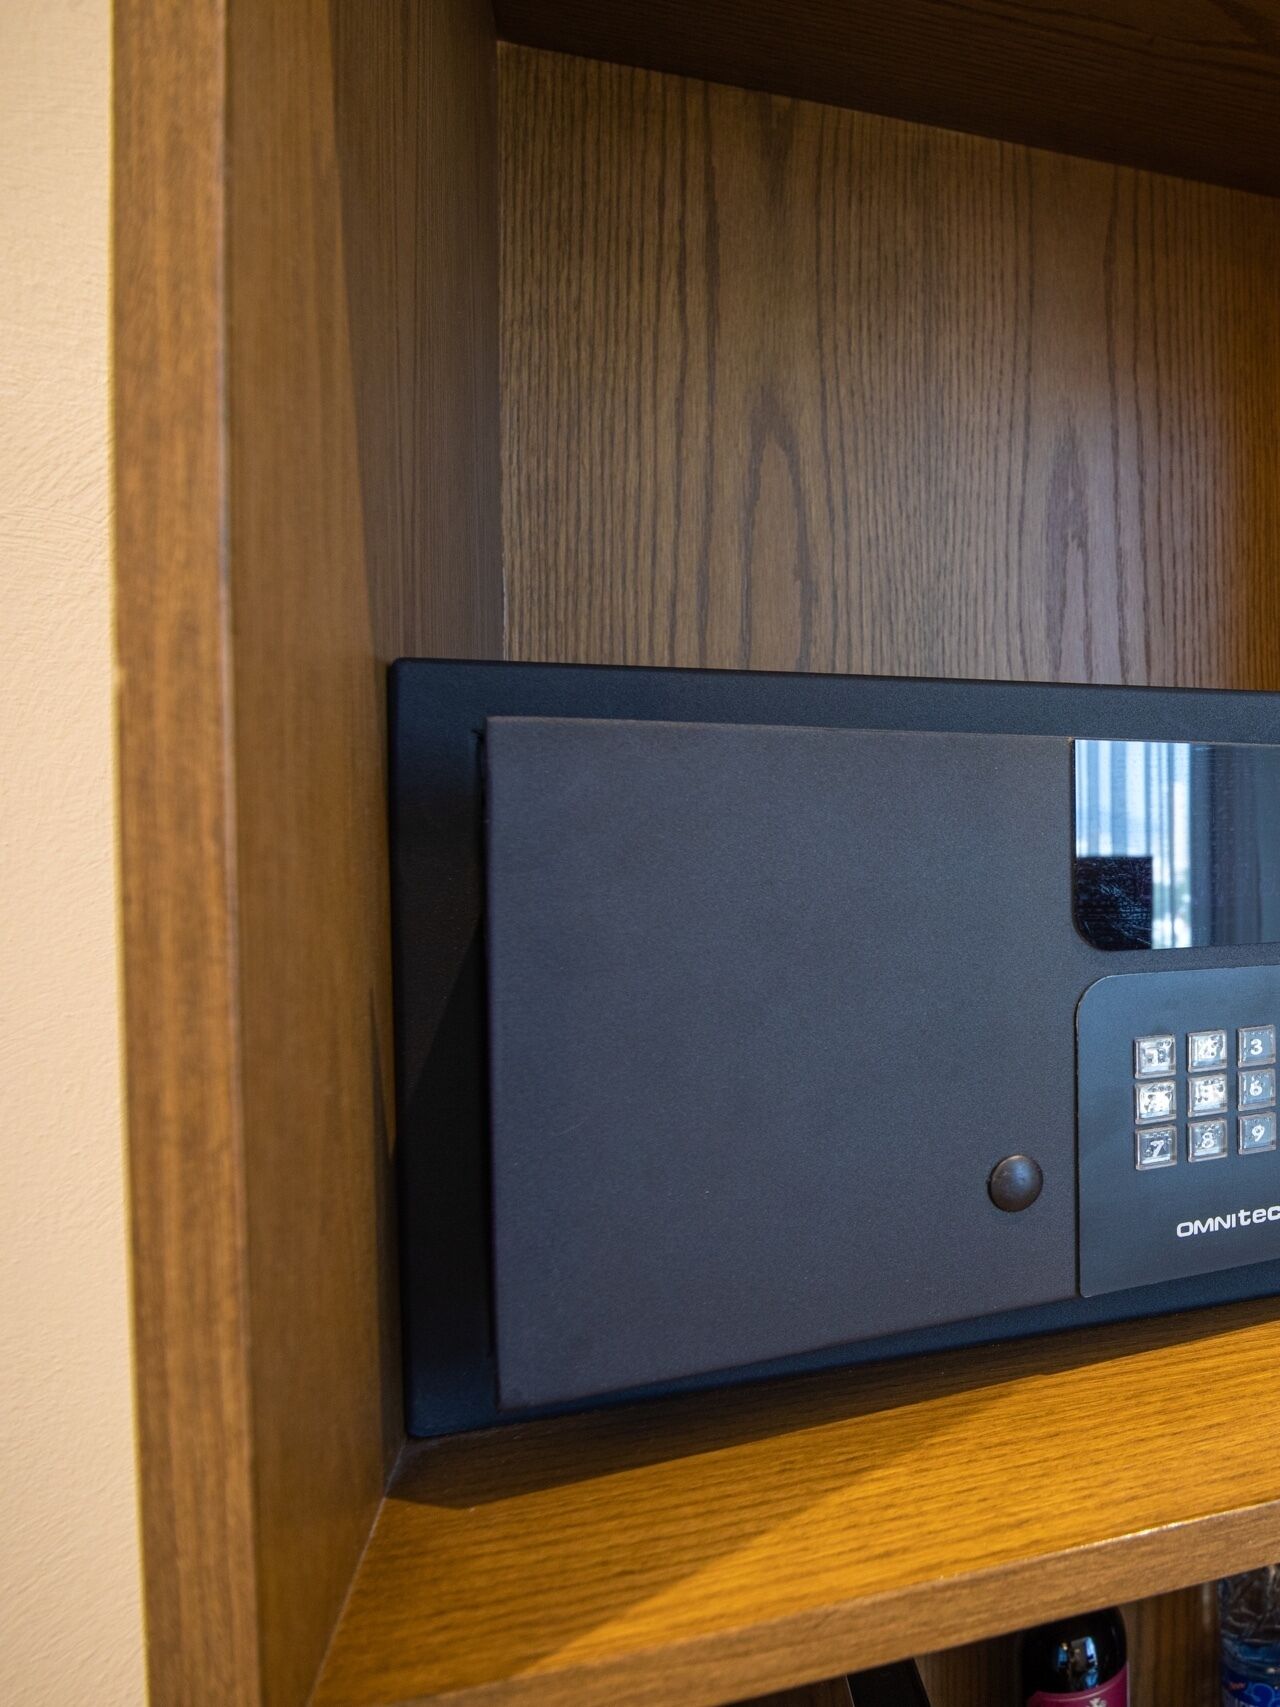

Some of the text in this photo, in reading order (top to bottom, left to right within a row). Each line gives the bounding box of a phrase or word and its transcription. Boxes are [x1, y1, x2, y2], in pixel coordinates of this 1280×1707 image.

[1251, 1039, 1263, 1055] 3
[1250, 1080, 1262, 1096] 6
[1150, 1140, 1165, 1157] 7
[1202, 1132, 1214, 1149] 8
[1252, 1125, 1265, 1142] 9
